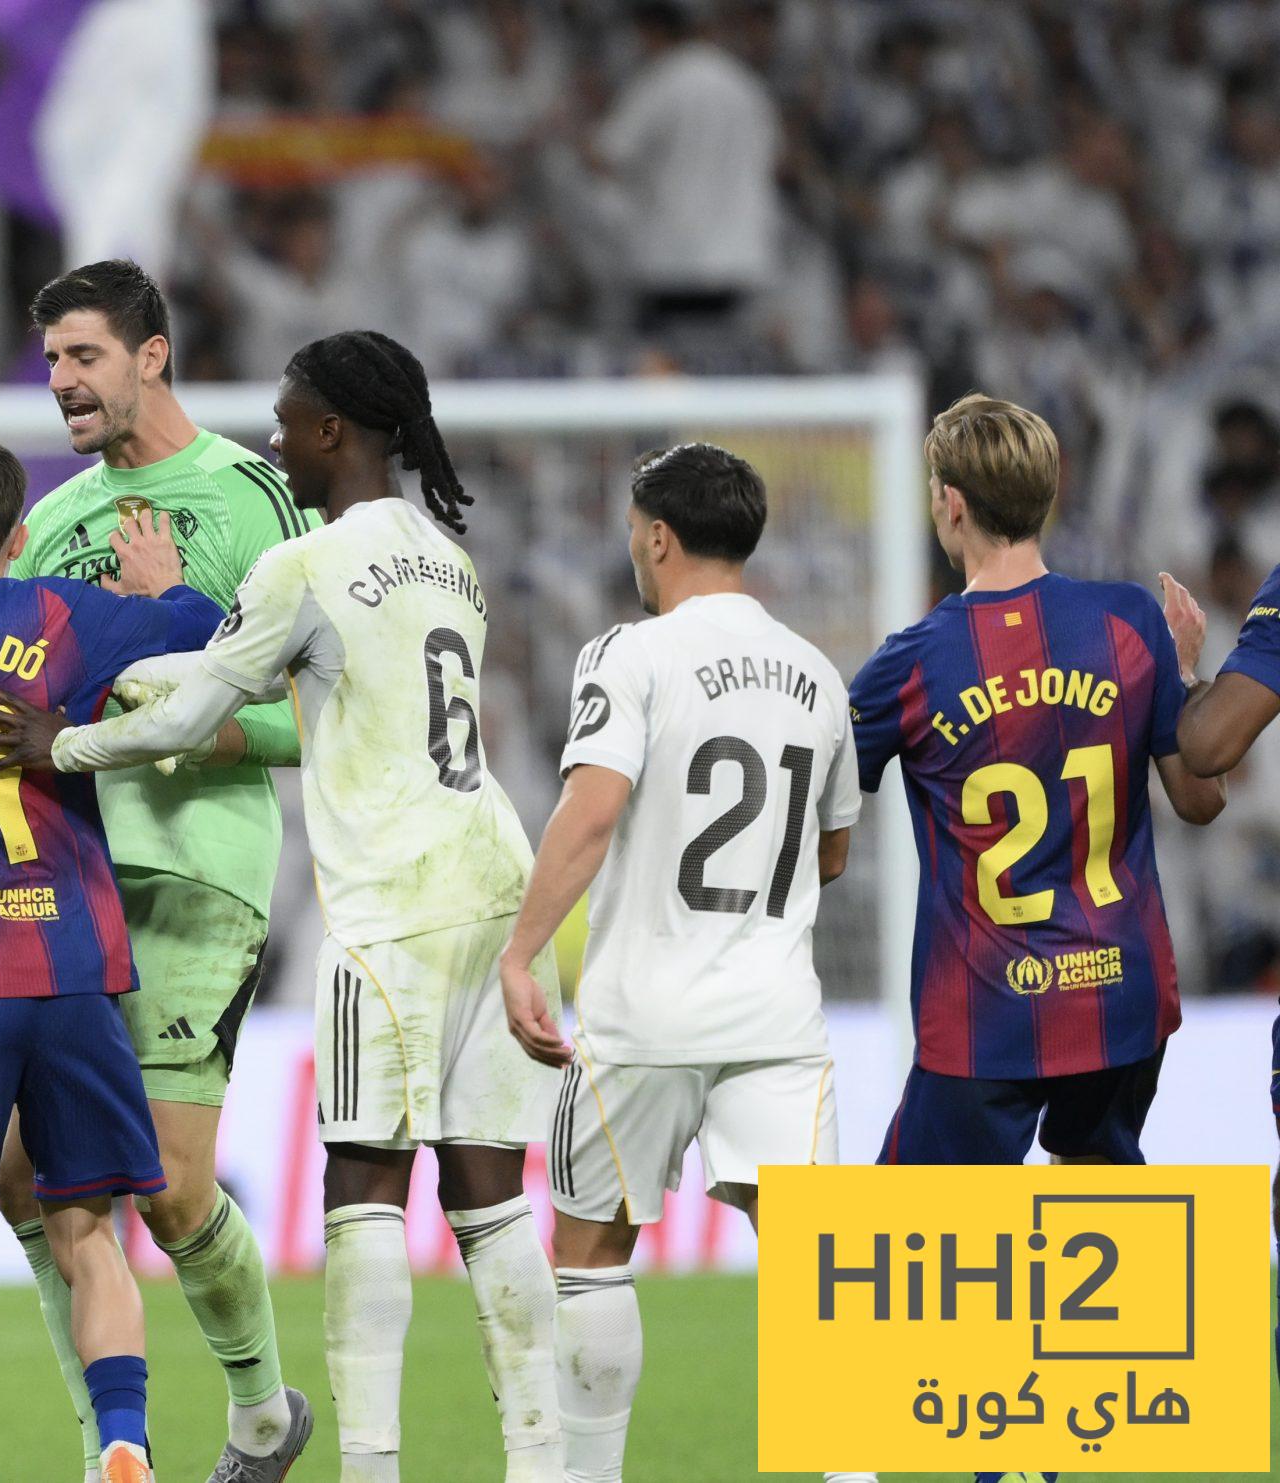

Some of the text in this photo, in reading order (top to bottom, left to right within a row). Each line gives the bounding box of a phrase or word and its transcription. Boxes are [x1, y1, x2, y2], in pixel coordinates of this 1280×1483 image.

[348, 553, 487, 621] CAMAVING
[423, 627, 482, 793] 6
[694, 656, 818, 713] BRAHIM
[932, 667, 1118, 746] F. DE JONG
[677, 736, 814, 919] 21
[961, 743, 1124, 925] 21
[1055, 946, 1121, 970] UNHCR
[1058, 961, 1122, 985] ACNUR
